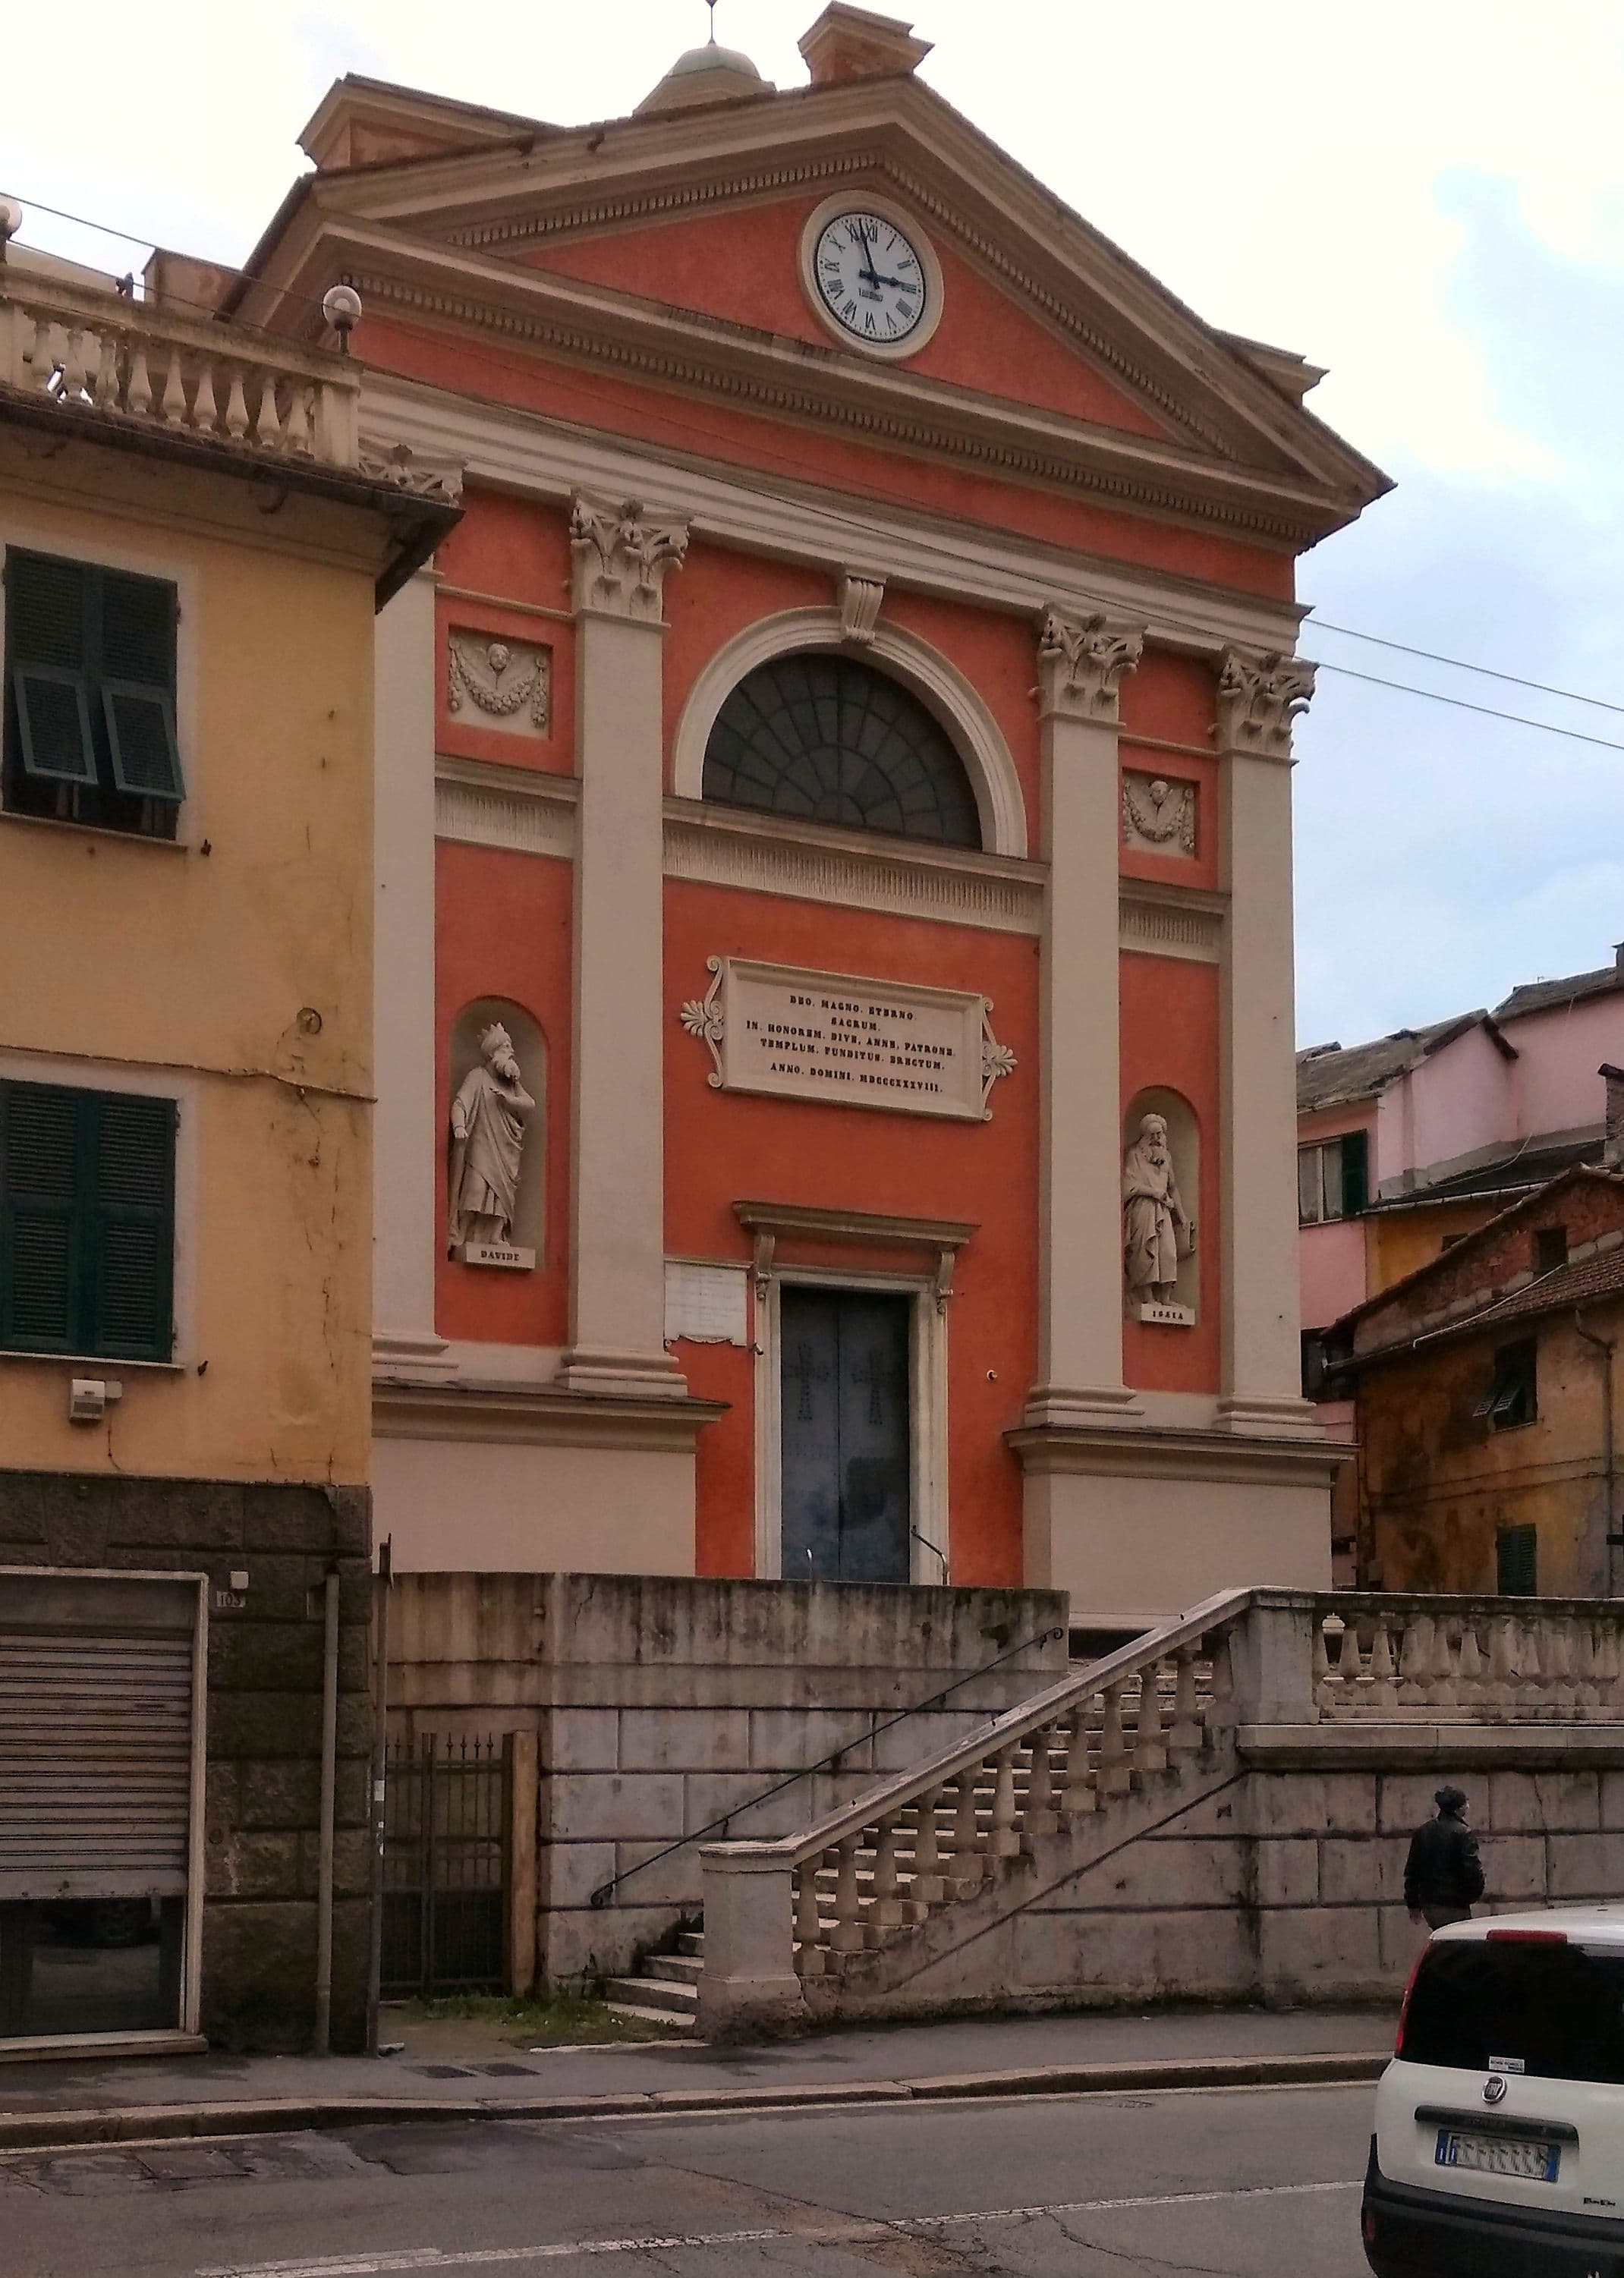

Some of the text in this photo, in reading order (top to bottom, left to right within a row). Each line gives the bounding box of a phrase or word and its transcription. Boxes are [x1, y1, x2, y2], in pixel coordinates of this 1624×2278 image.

[790, 995, 917, 1021] DEO. MAGNO. ETERNO.
[746, 1020, 763, 1031] IN.
[768, 1024, 826, 1040] HONOREM.
[831, 1017, 881, 1031] SACRUM.
[760, 1037, 946, 1070] TEMPLUM. FUNDITUS. ERECTUM.
[770, 1062, 805, 1075] ANNO.
[810, 1068, 855, 1081] DOMINI.
[480, 1250, 521, 1261] DAVIDE
